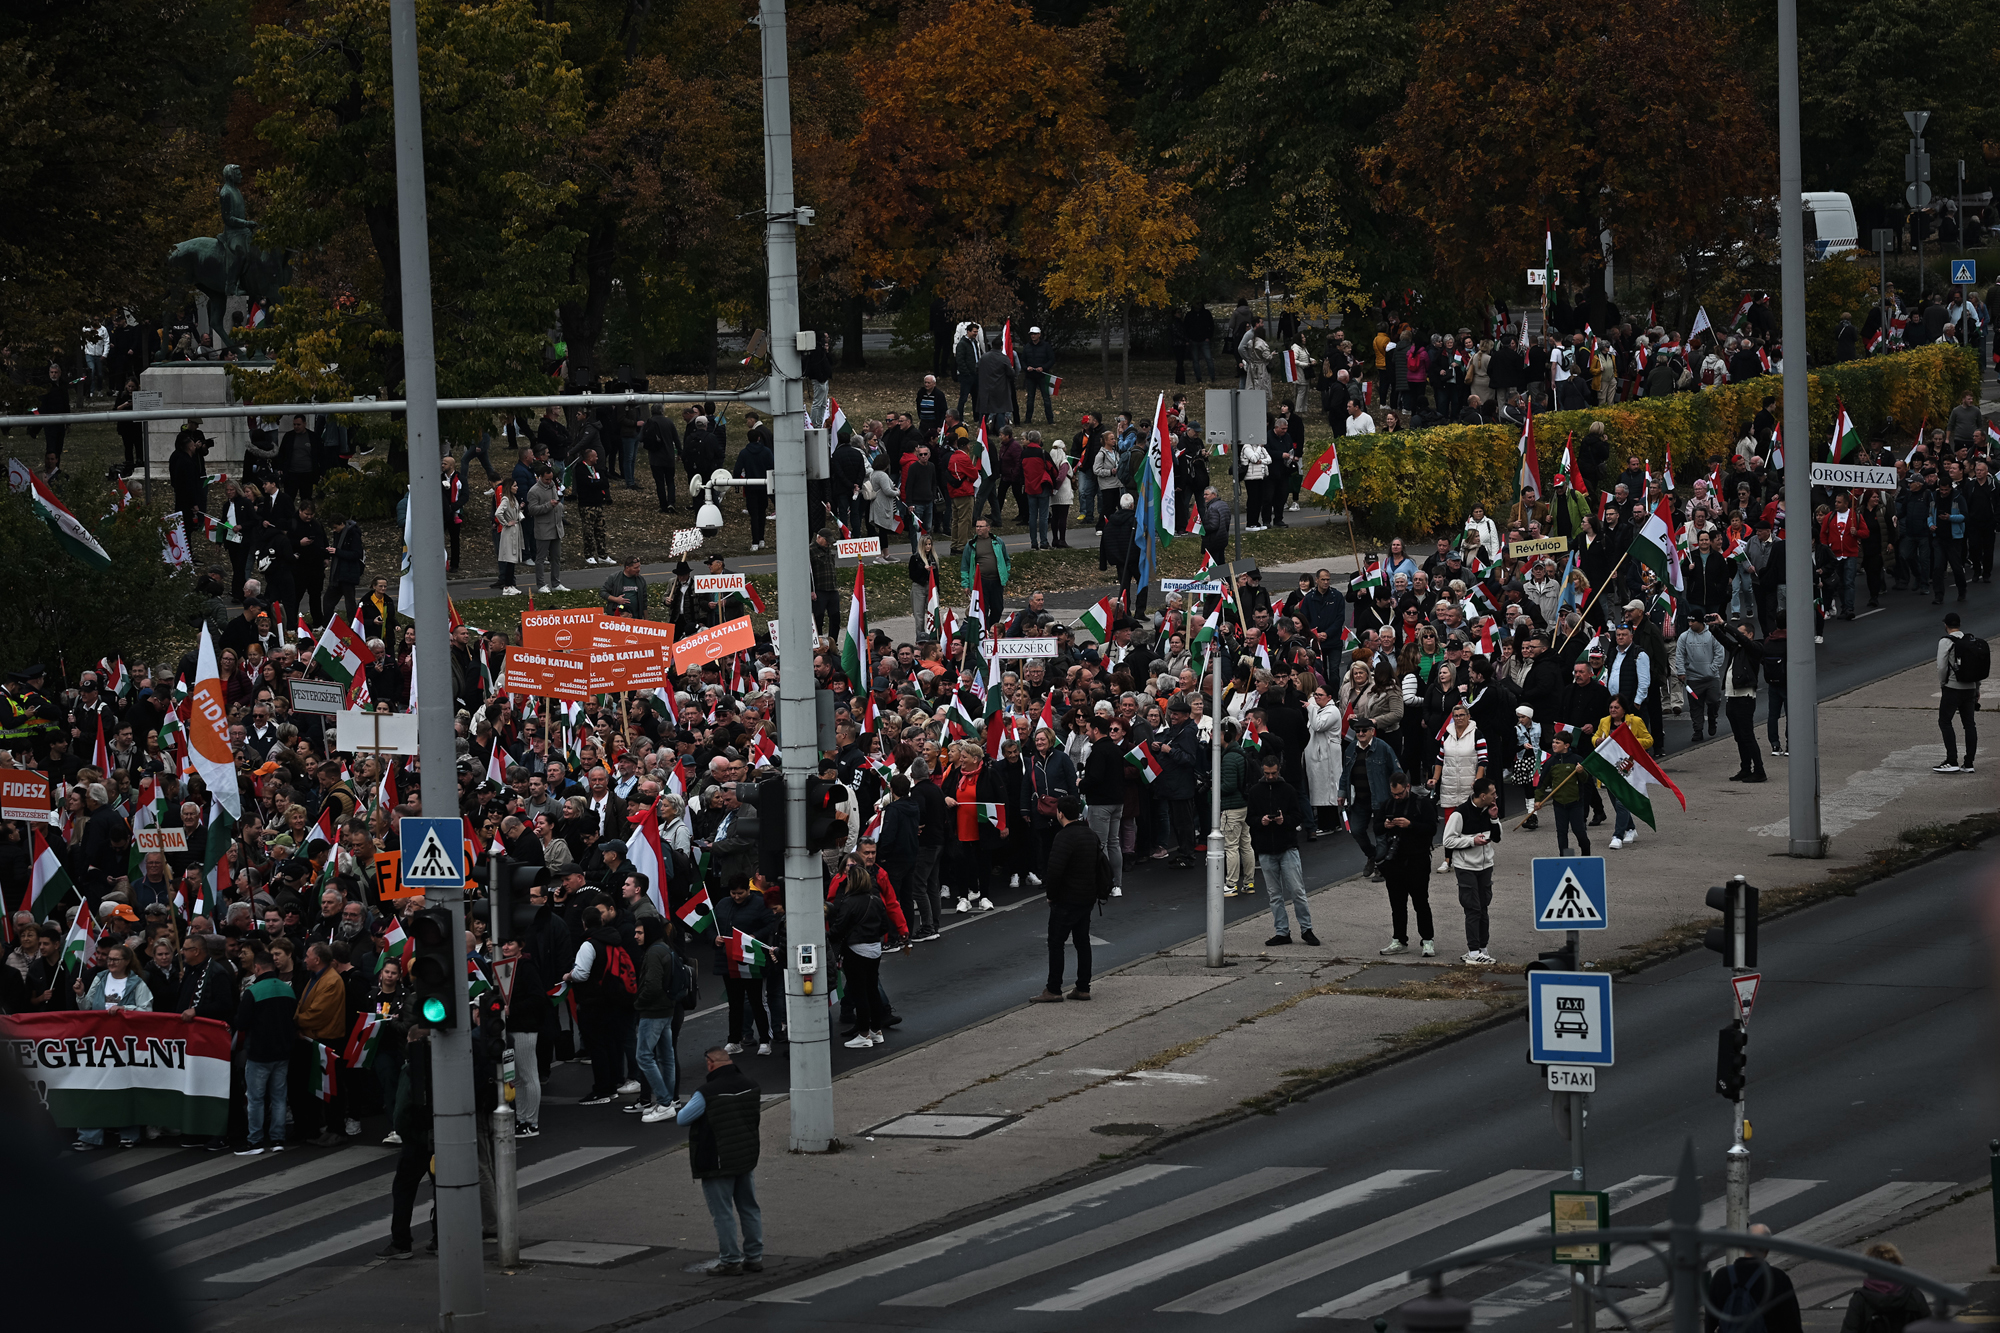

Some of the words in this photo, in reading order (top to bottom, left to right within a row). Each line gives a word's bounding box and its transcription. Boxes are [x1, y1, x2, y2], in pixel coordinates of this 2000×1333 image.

[1813, 468, 1895, 484] OROSHÁZA
[72, 525, 99, 546] RAJK
[838, 539, 878, 555] VESZKÉNY
[1516, 541, 1561, 554] Révfülöp
[696, 574, 743, 590] KAPUVÁR
[525, 614, 561, 627] CSÖBÖR
[562, 613, 595, 625] KATALI
[599, 621, 631, 633] CSÖBÖR
[632, 625, 667, 637] KATALIN
[710, 620, 749, 639] KATALIN
[513, 652, 547, 666] CSÖBÖR
[548, 657, 584, 670] KATALIN
[616, 649, 655, 660] KATALIN
[2, 781, 47, 799] FIDESZ
[1558, 999, 1583, 1010] TAXI
